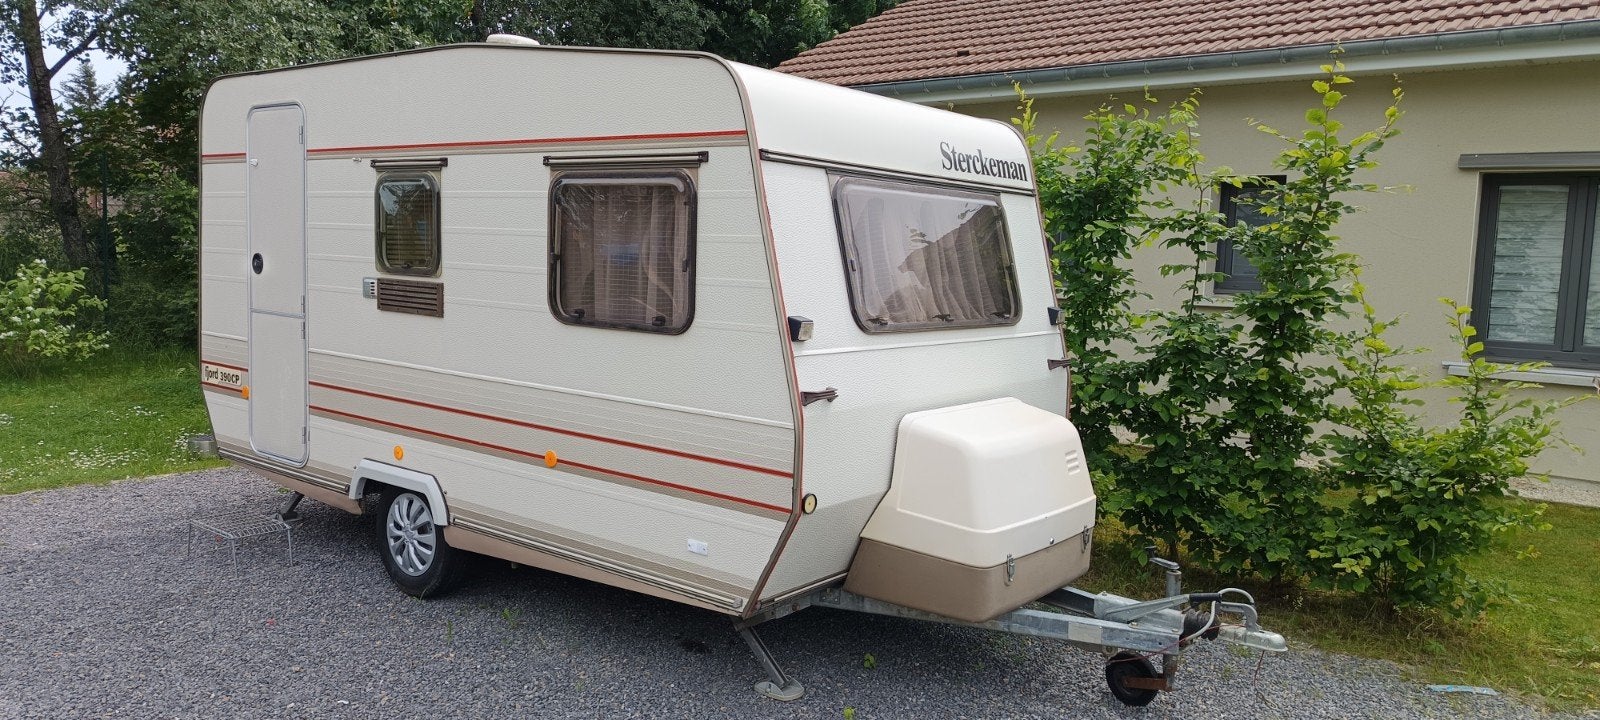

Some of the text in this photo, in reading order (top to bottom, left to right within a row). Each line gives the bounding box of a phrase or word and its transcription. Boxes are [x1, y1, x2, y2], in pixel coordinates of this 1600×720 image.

[940, 141, 1028, 181] Sterckeman
[204, 365, 240, 384] fjord 390CP
